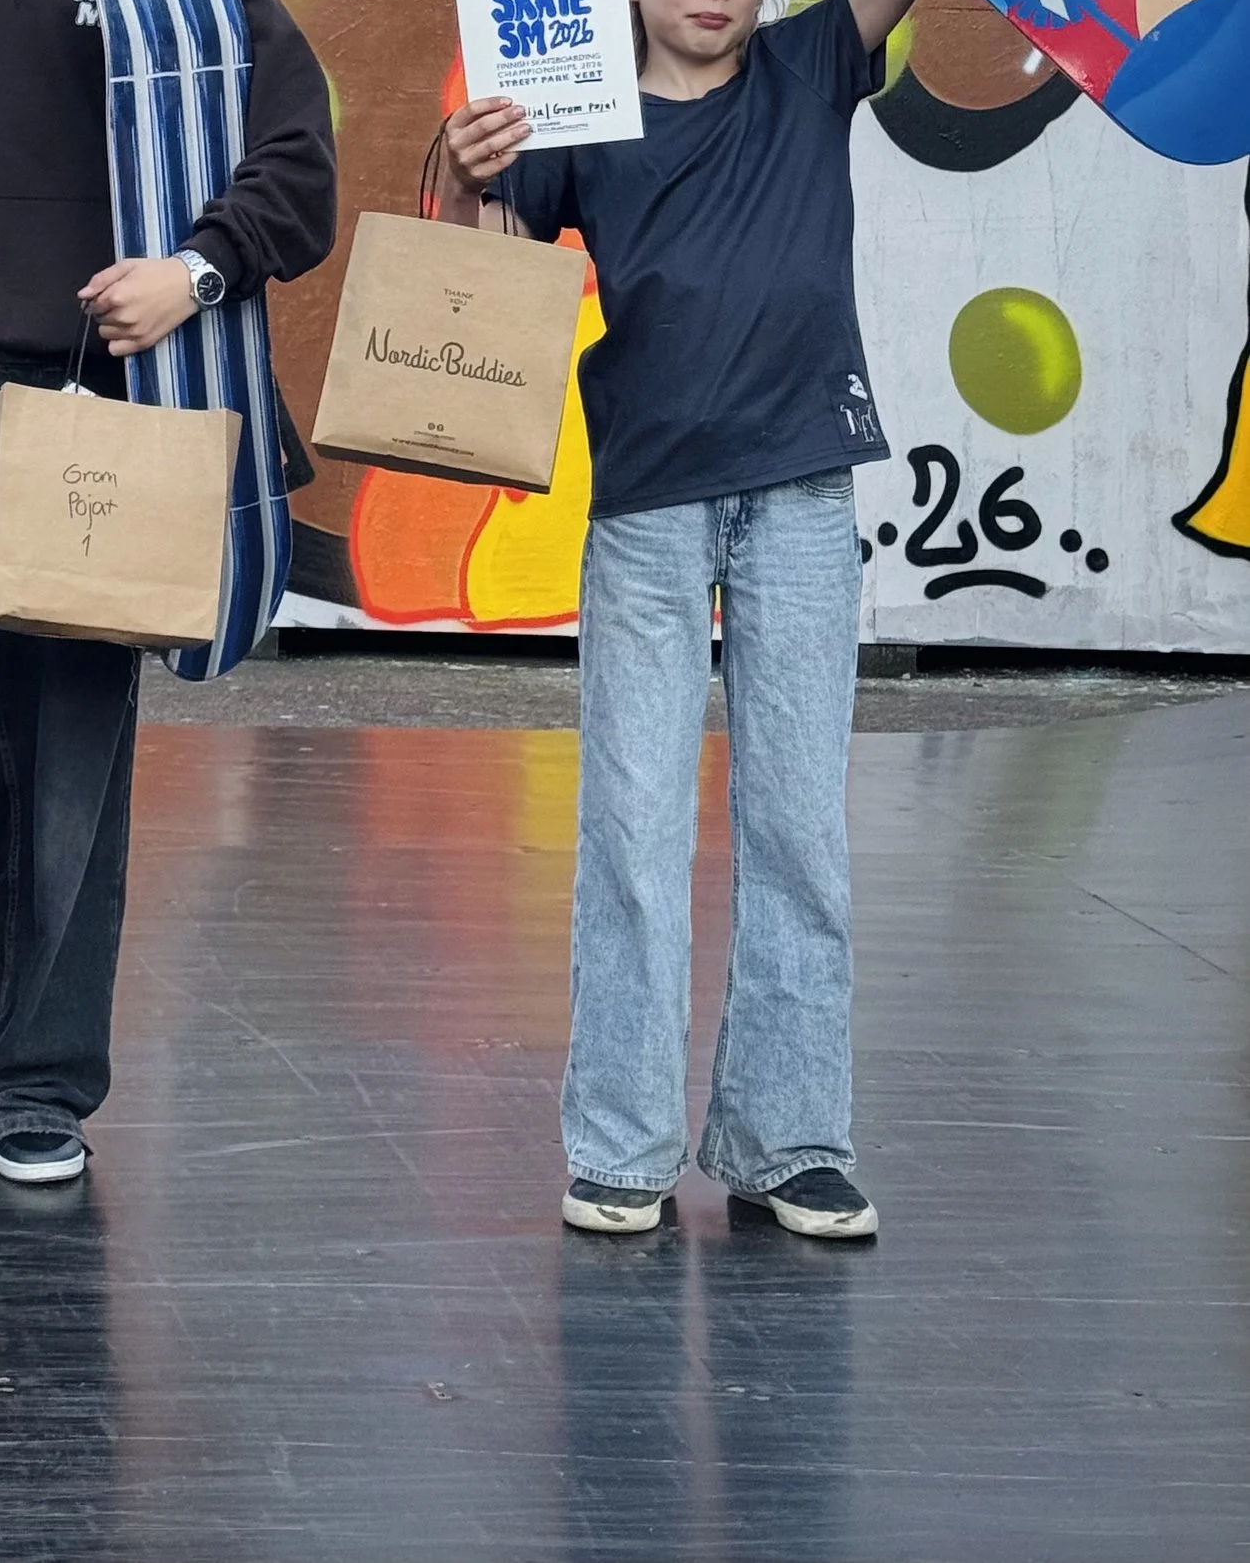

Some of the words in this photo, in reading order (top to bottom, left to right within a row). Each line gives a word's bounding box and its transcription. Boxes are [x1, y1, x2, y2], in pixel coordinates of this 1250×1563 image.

[498, 16, 547, 59] SM
[549, 18, 594, 49] 2026
[364, 326, 527, 387] NordicBuddies
[68, 491, 119, 531] Pojat
